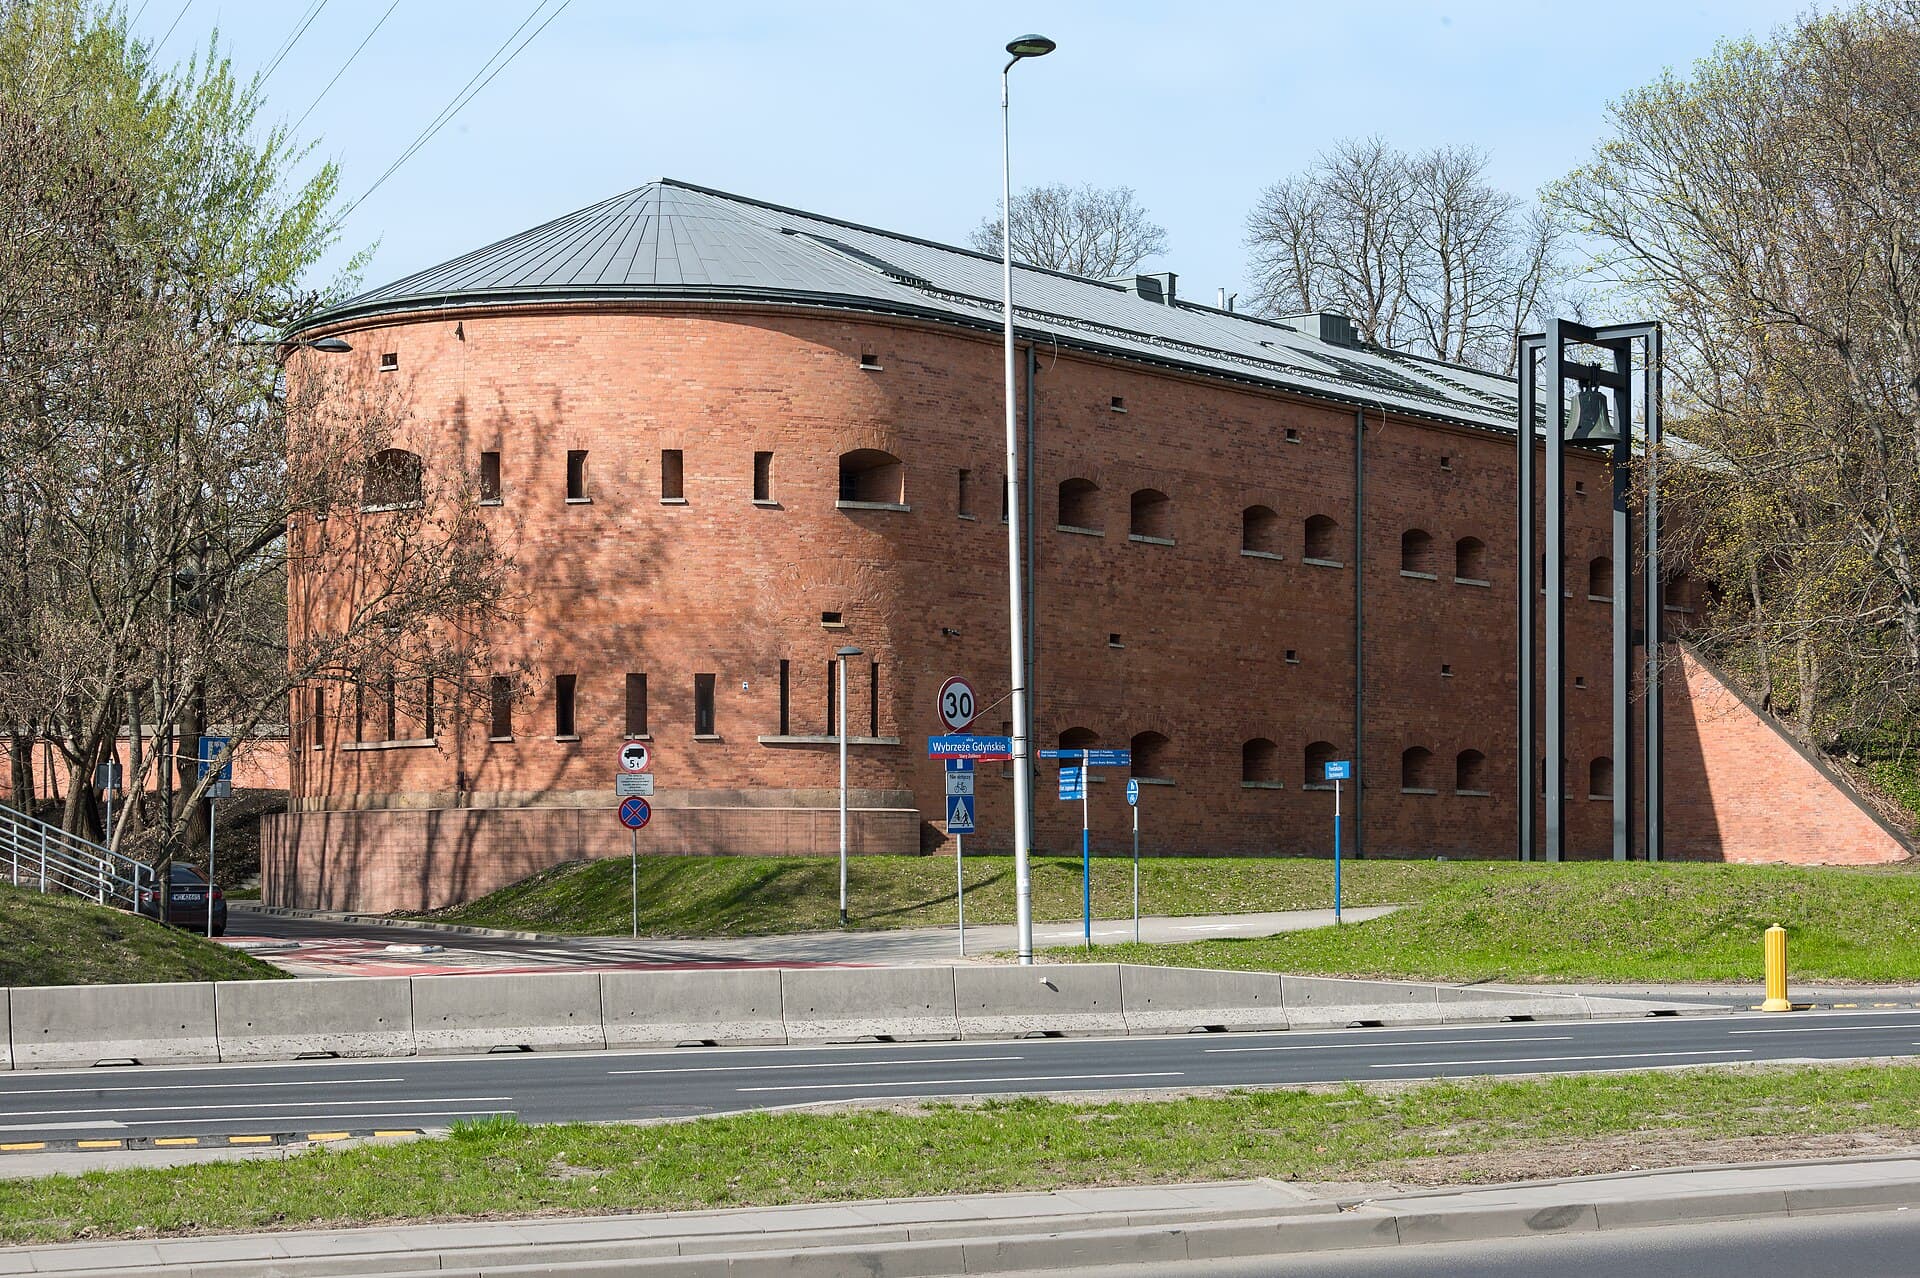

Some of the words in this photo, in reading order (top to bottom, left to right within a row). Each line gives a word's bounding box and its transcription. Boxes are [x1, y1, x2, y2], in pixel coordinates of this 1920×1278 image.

[945, 692, 972, 719] 30
[932, 741, 970, 753] Wybrzeże
[972, 741, 1006, 753] Gdyńskie
[629, 760, 635, 768] 5
